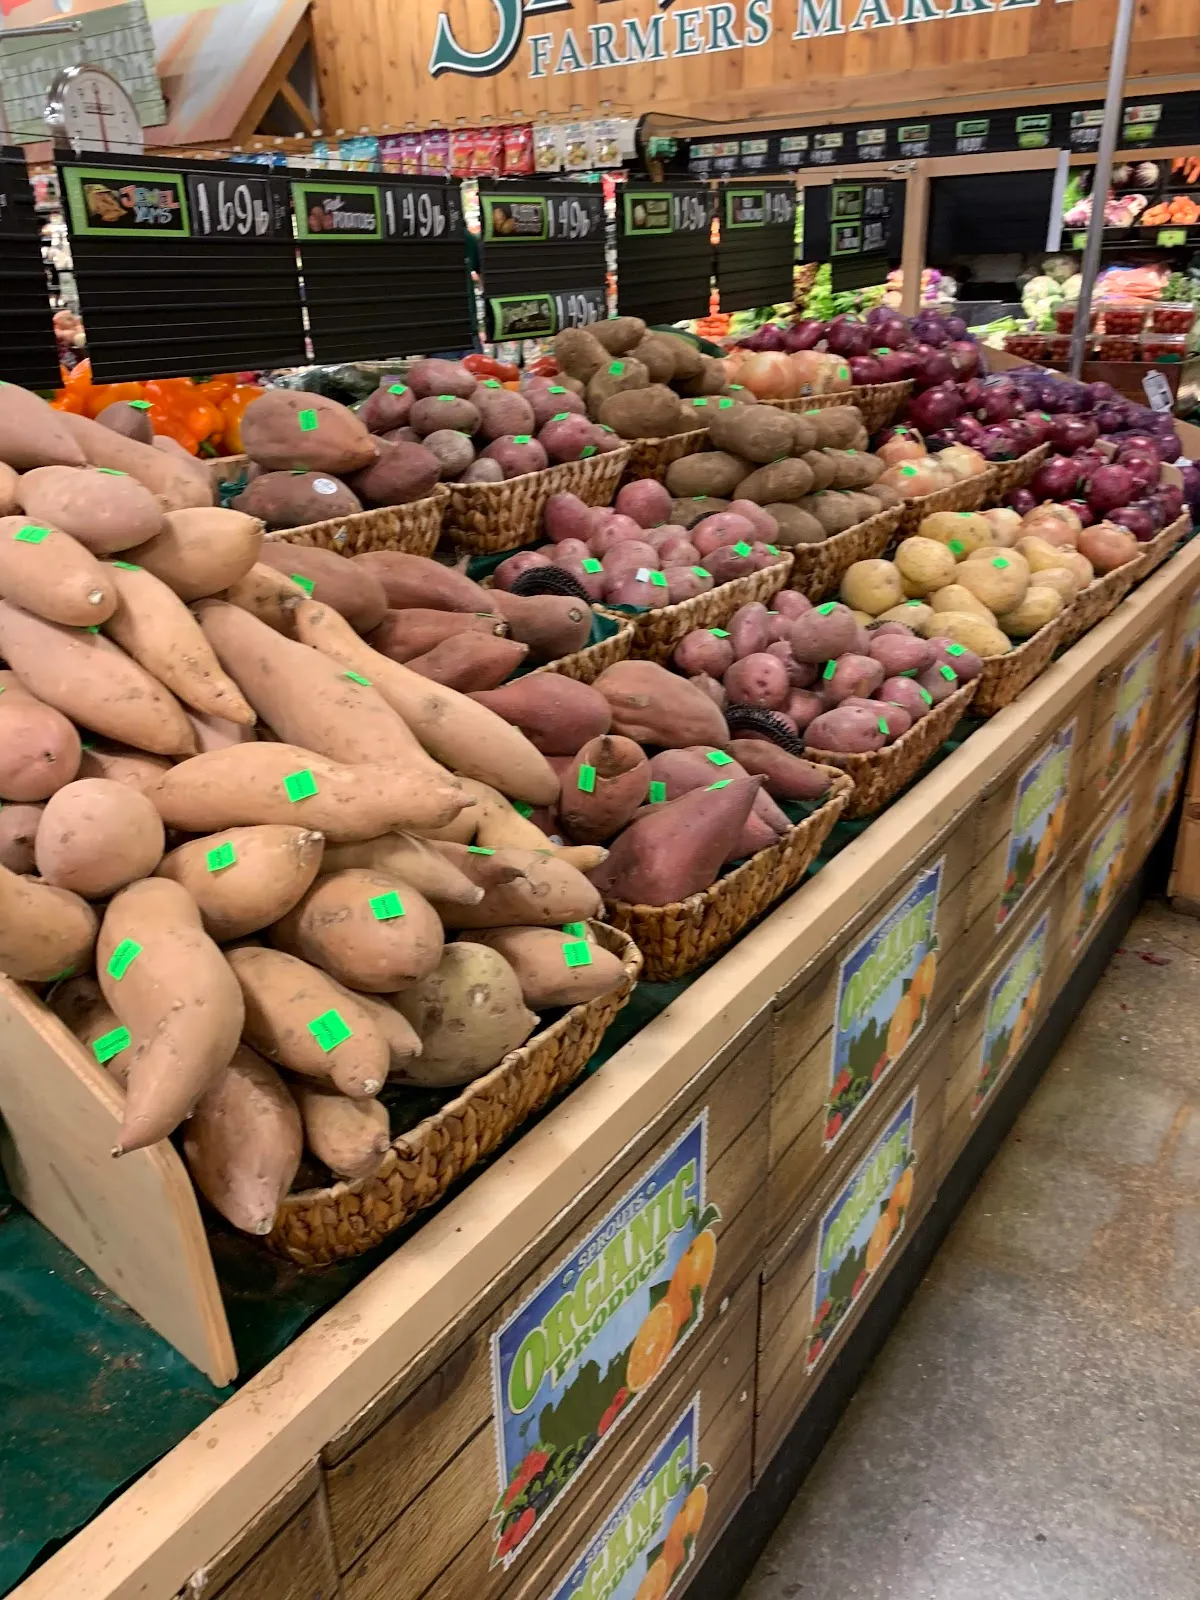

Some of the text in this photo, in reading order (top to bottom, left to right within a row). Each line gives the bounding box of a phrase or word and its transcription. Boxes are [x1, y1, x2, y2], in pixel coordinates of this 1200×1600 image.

[528, 0, 774, 79] FARMERS
[507, 1156, 697, 1415] ORGANIC
[577, 1191, 645, 1272] SPROUTS
[551, 1239, 669, 1389] PRODUCE
[568, 1434, 691, 1600] GANIC
